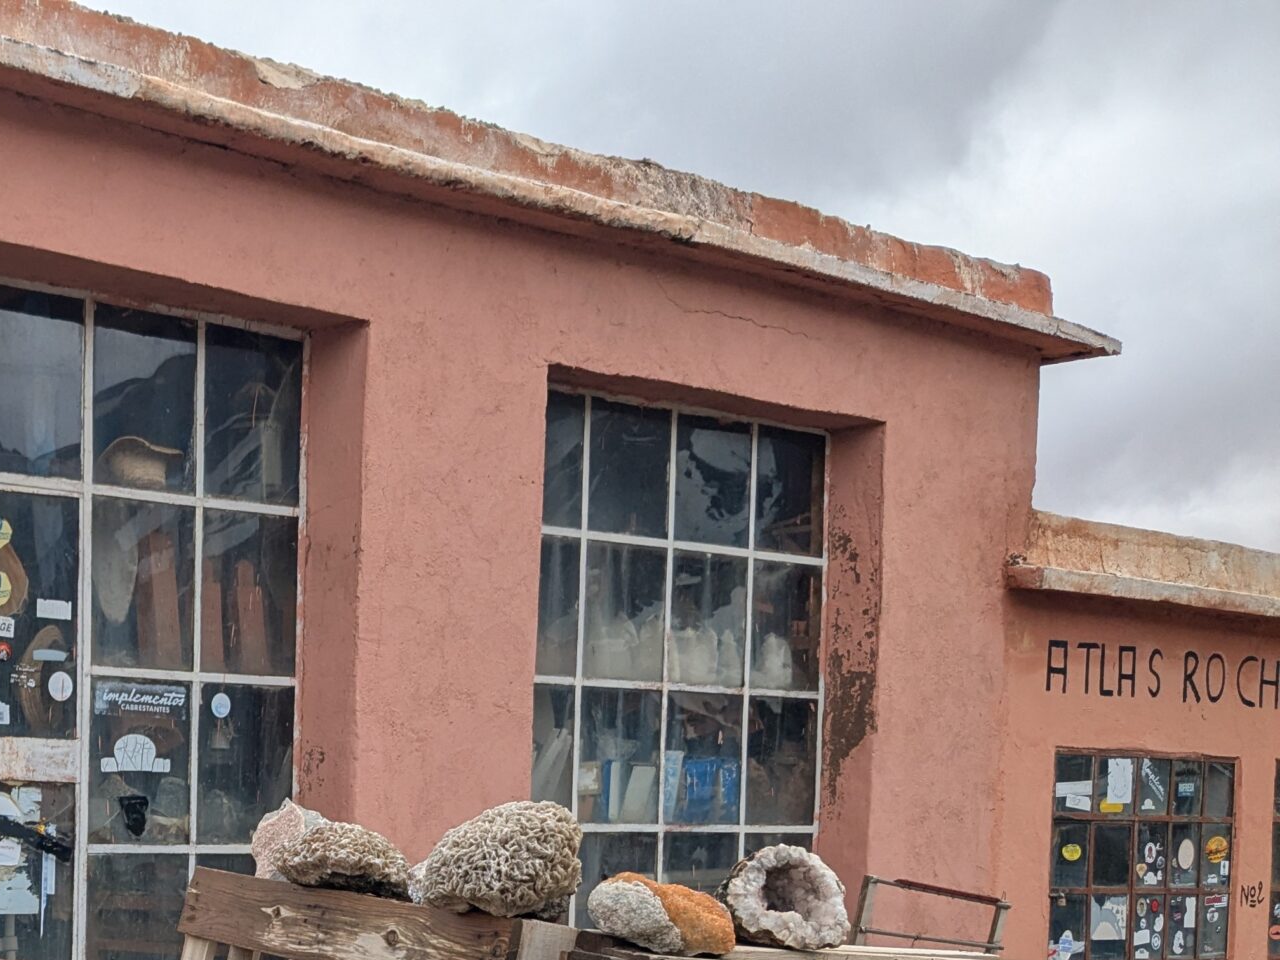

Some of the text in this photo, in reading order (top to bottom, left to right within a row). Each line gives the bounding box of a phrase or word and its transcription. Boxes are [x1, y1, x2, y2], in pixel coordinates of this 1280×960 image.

[103, 688, 186, 706] implementos
[1046, 640, 1164, 698] ATLAS
[1182, 650, 1280, 710] ROCH
